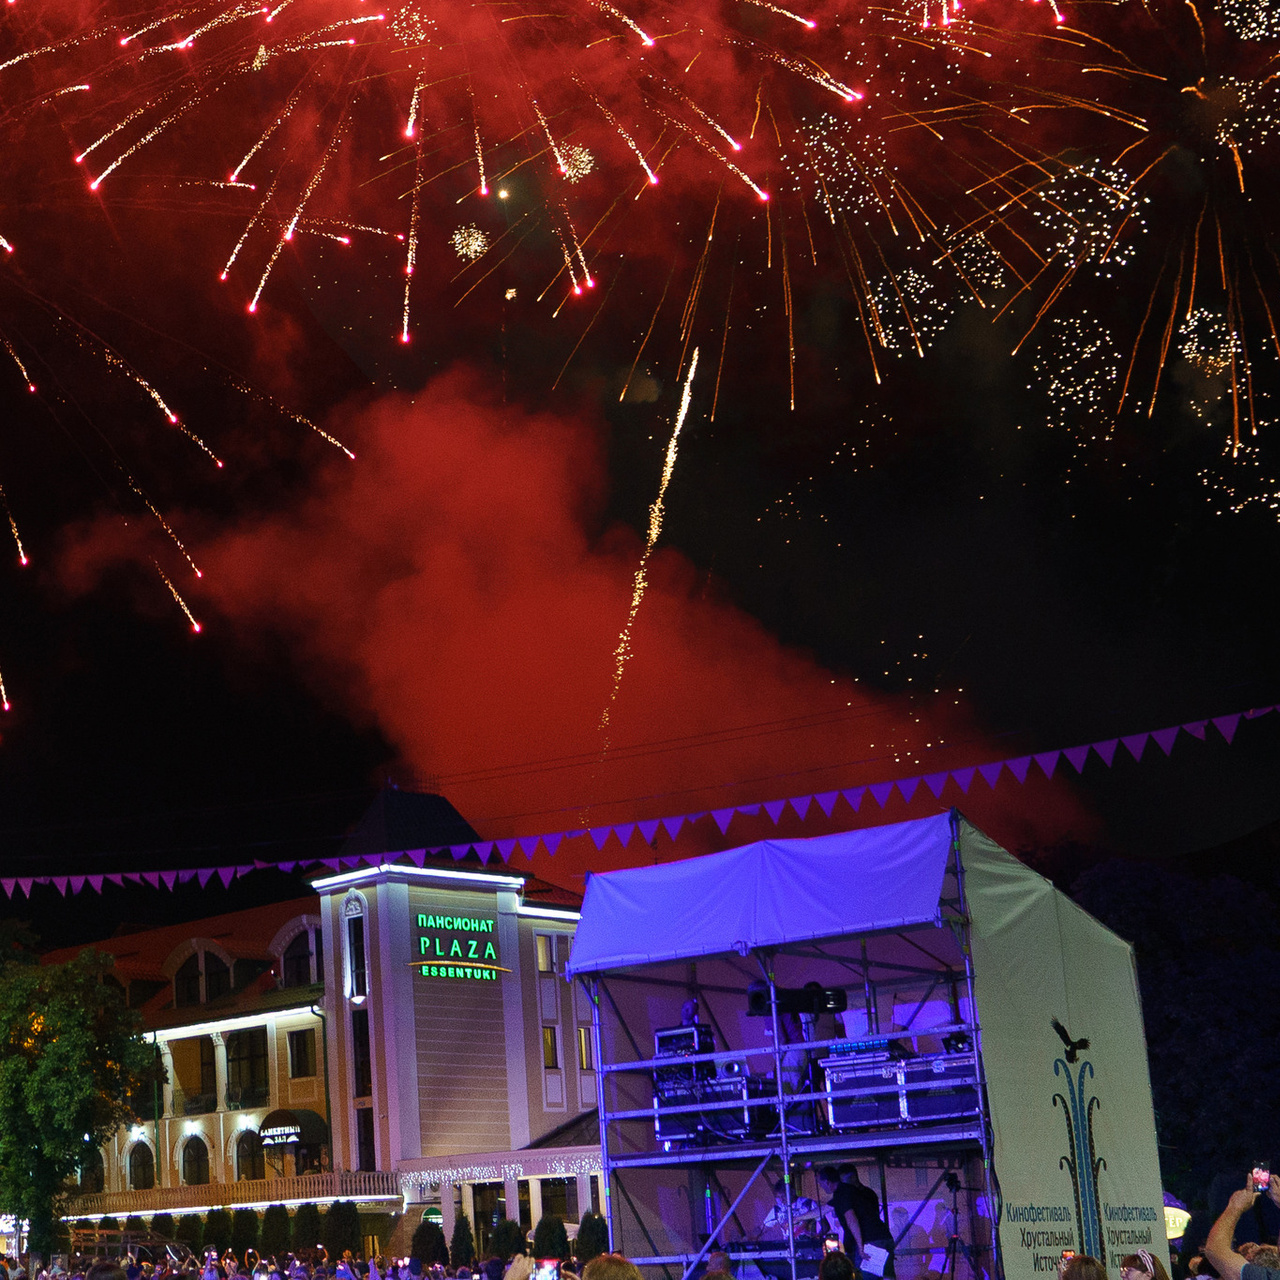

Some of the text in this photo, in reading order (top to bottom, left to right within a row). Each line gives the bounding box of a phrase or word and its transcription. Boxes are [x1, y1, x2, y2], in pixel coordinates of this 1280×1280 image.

[418, 913, 494, 933] ПАНСИОНАТ
[419, 936, 497, 960] PLAZA
[421, 965, 497, 980] ESSENTUKI
[1006, 1203, 1071, 1225] Кинофестиваль
[1103, 1203, 1157, 1224] Кинофестиваль
[1020, 1227, 1075, 1250] Хрустальный
[1106, 1227, 1153, 1247] Хрустальный
[1033, 1253, 1062, 1272] Источ
